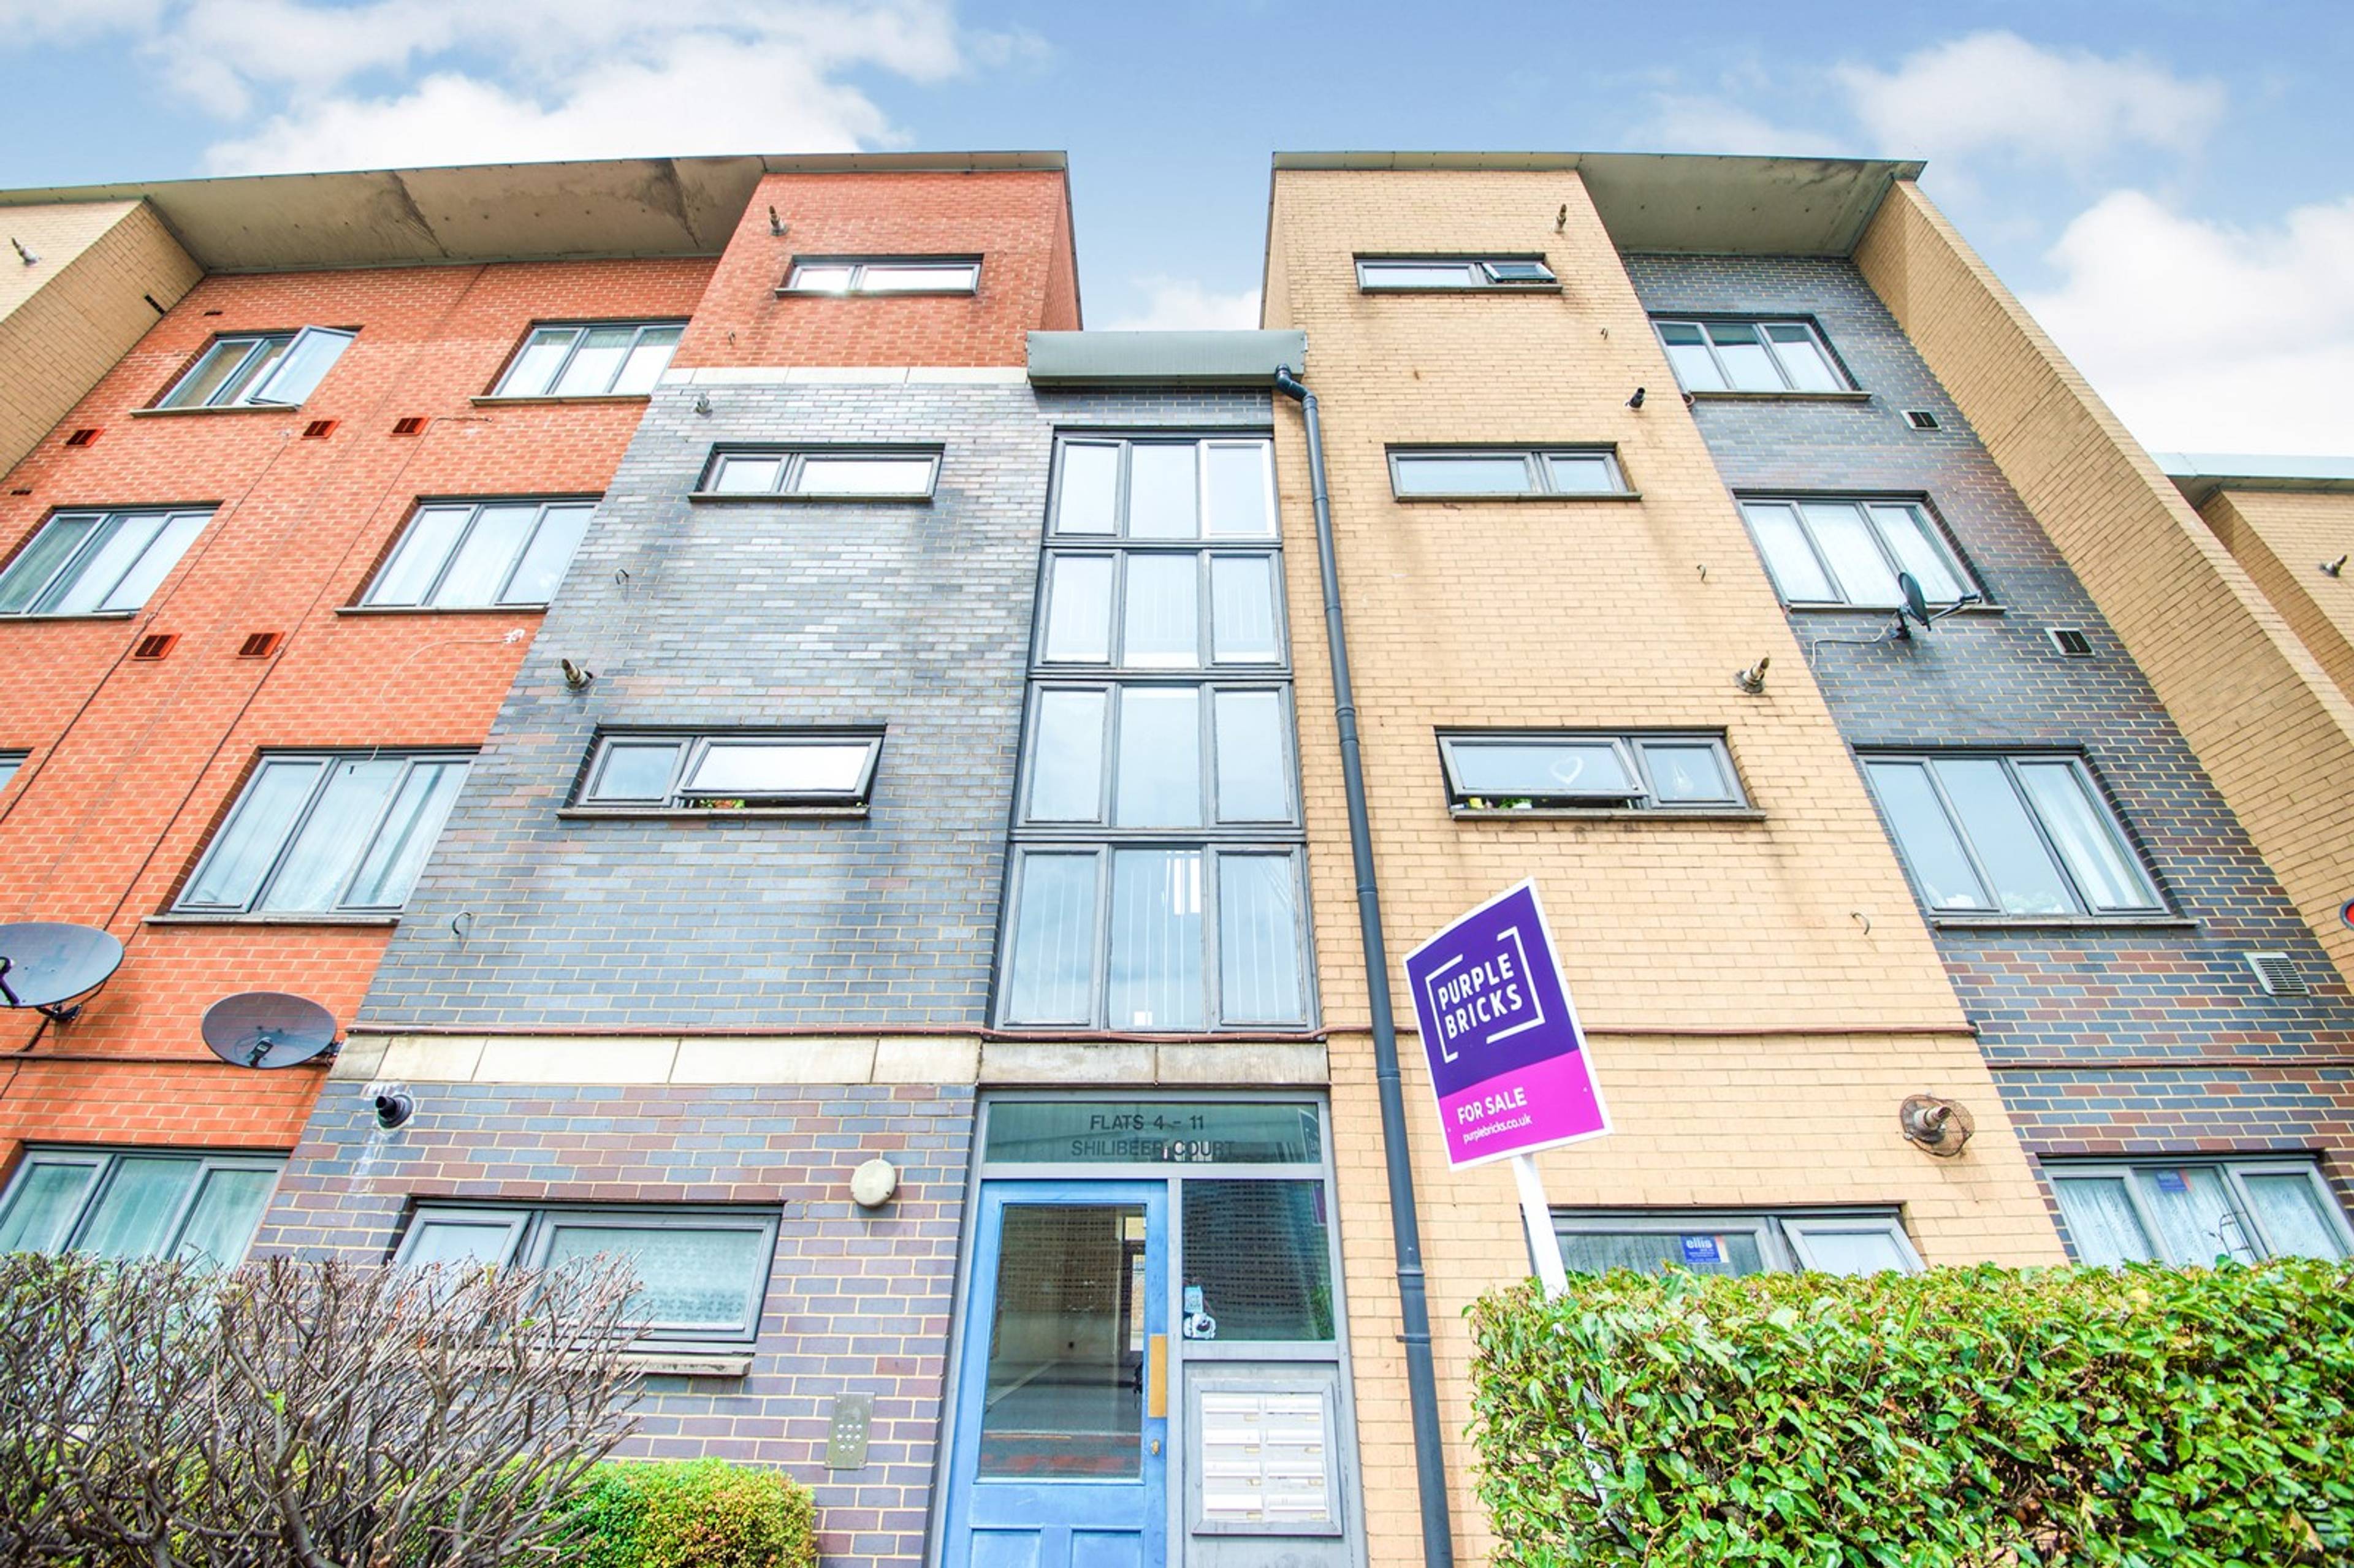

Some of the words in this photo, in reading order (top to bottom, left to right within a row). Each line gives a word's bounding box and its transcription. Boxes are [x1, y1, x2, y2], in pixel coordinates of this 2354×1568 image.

[1438, 953, 1514, 1011] PURPLE
[1445, 983, 1522, 1039] BRICKS
[1090, 1114, 1144, 1130] FLATS
[1154, 1114, 1164, 1130] 4
[1190, 1114, 1203, 1130] 11
[1457, 1102, 1484, 1125] FOR
[1485, 1087, 1528, 1115] SALE
[1463, 1114, 1533, 1145] purplebricks.co.uk
[1072, 1140, 1164, 1156] SHILIBEER
[1173, 1140, 1235, 1156] COURT
